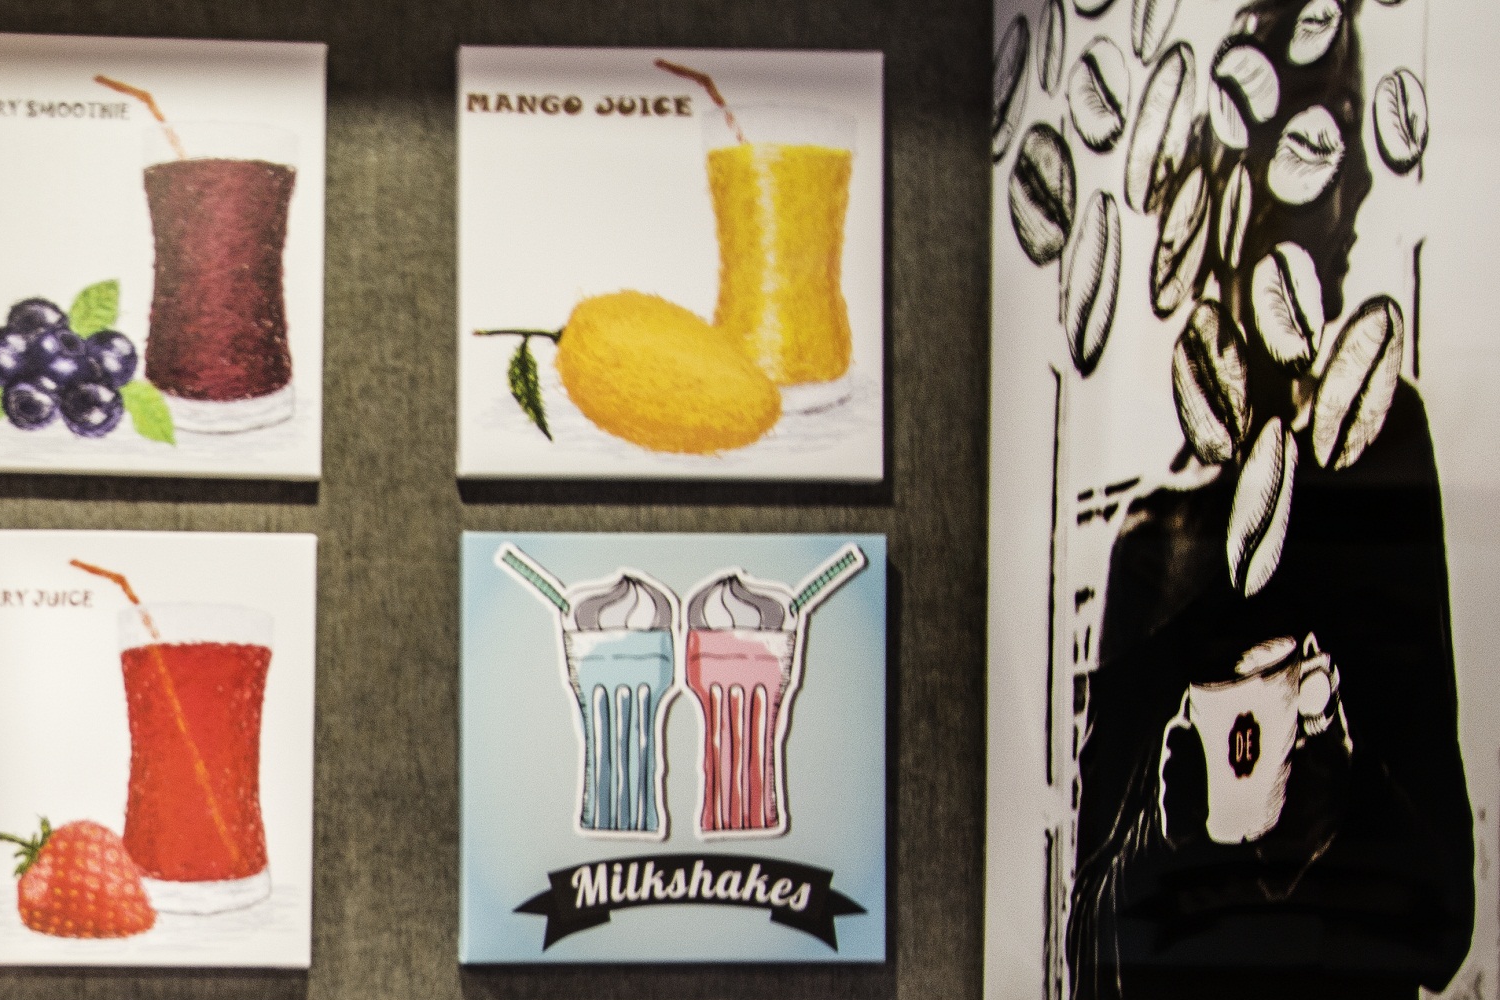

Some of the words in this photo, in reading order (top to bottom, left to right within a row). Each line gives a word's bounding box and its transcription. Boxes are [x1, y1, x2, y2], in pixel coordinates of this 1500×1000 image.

[26, 100, 131, 121] SMOOTHIE
[466, 92, 583, 116] MANGO
[595, 94, 693, 117] JUICE
[32, 588, 94, 608] JUICE
[571, 860, 812, 911] Milkshakes
